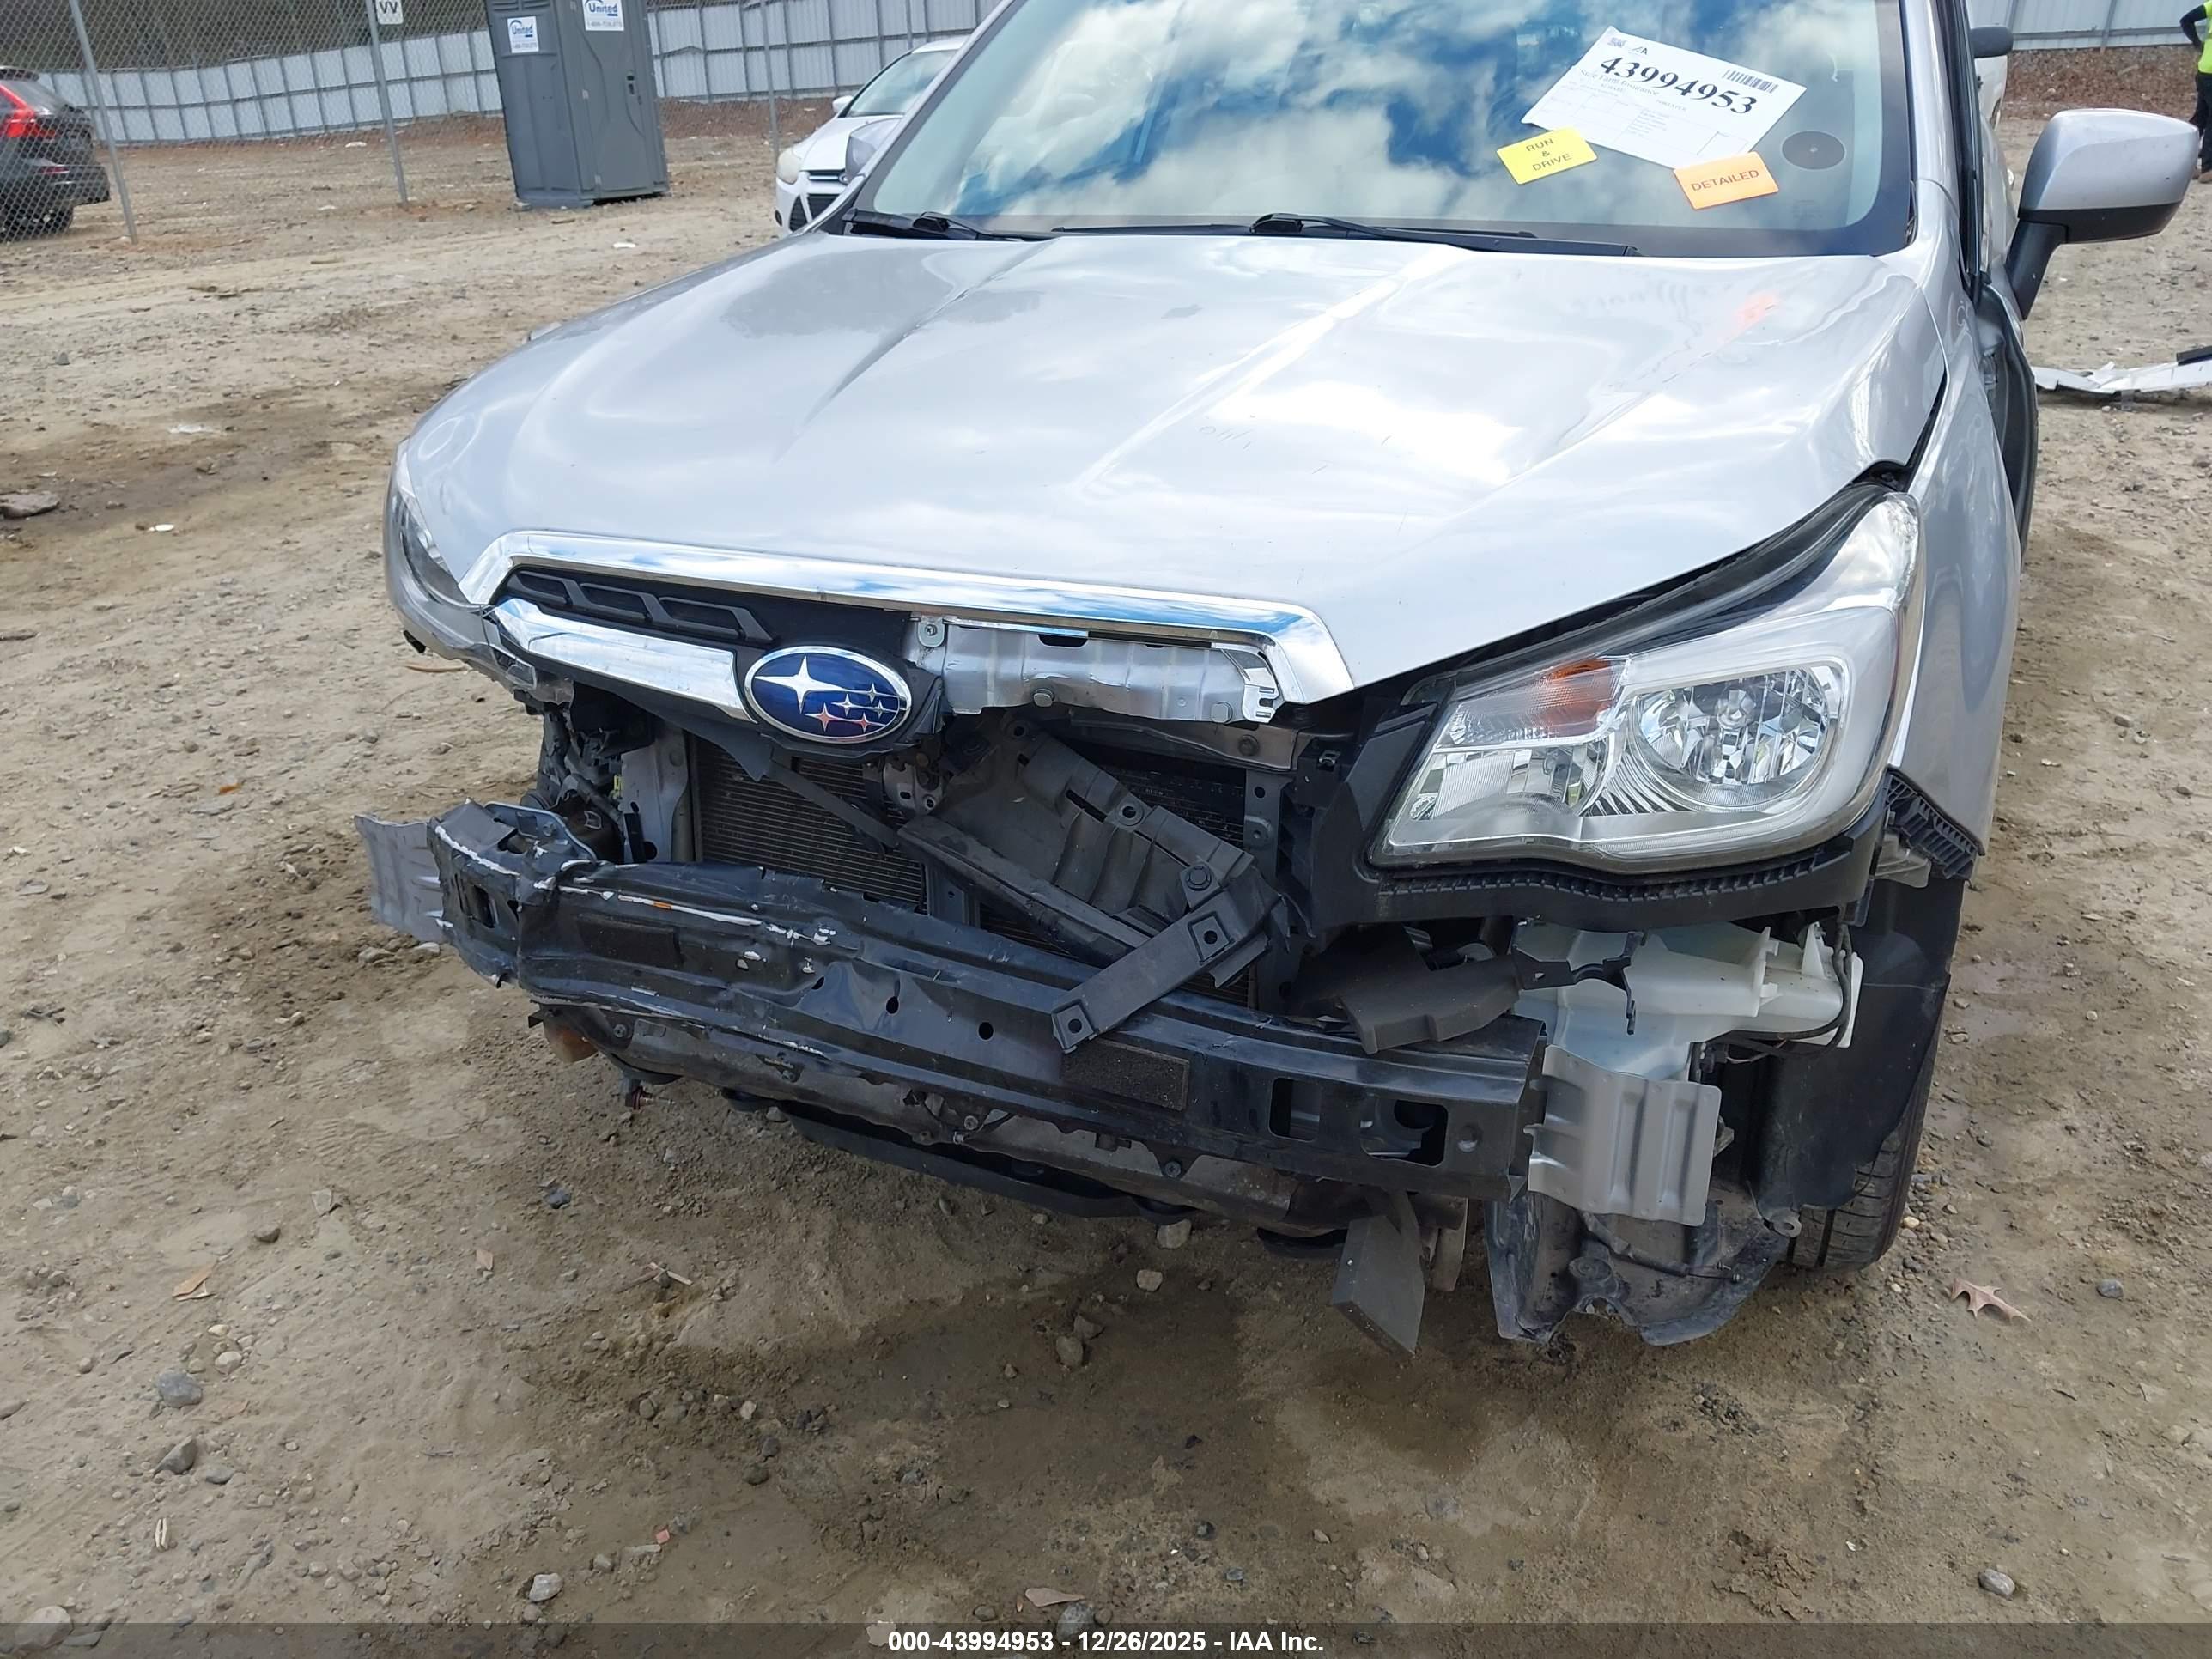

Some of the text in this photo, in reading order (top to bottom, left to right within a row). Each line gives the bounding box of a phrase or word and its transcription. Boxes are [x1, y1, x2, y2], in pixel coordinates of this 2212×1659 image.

[588, 3, 618, 13] United
[1601, 57, 1757, 113] 43994953
[1526, 138, 1553, 151] RUN
[1532, 153, 1572, 171] DRIVE
[1691, 170, 1759, 191] DETAILED
